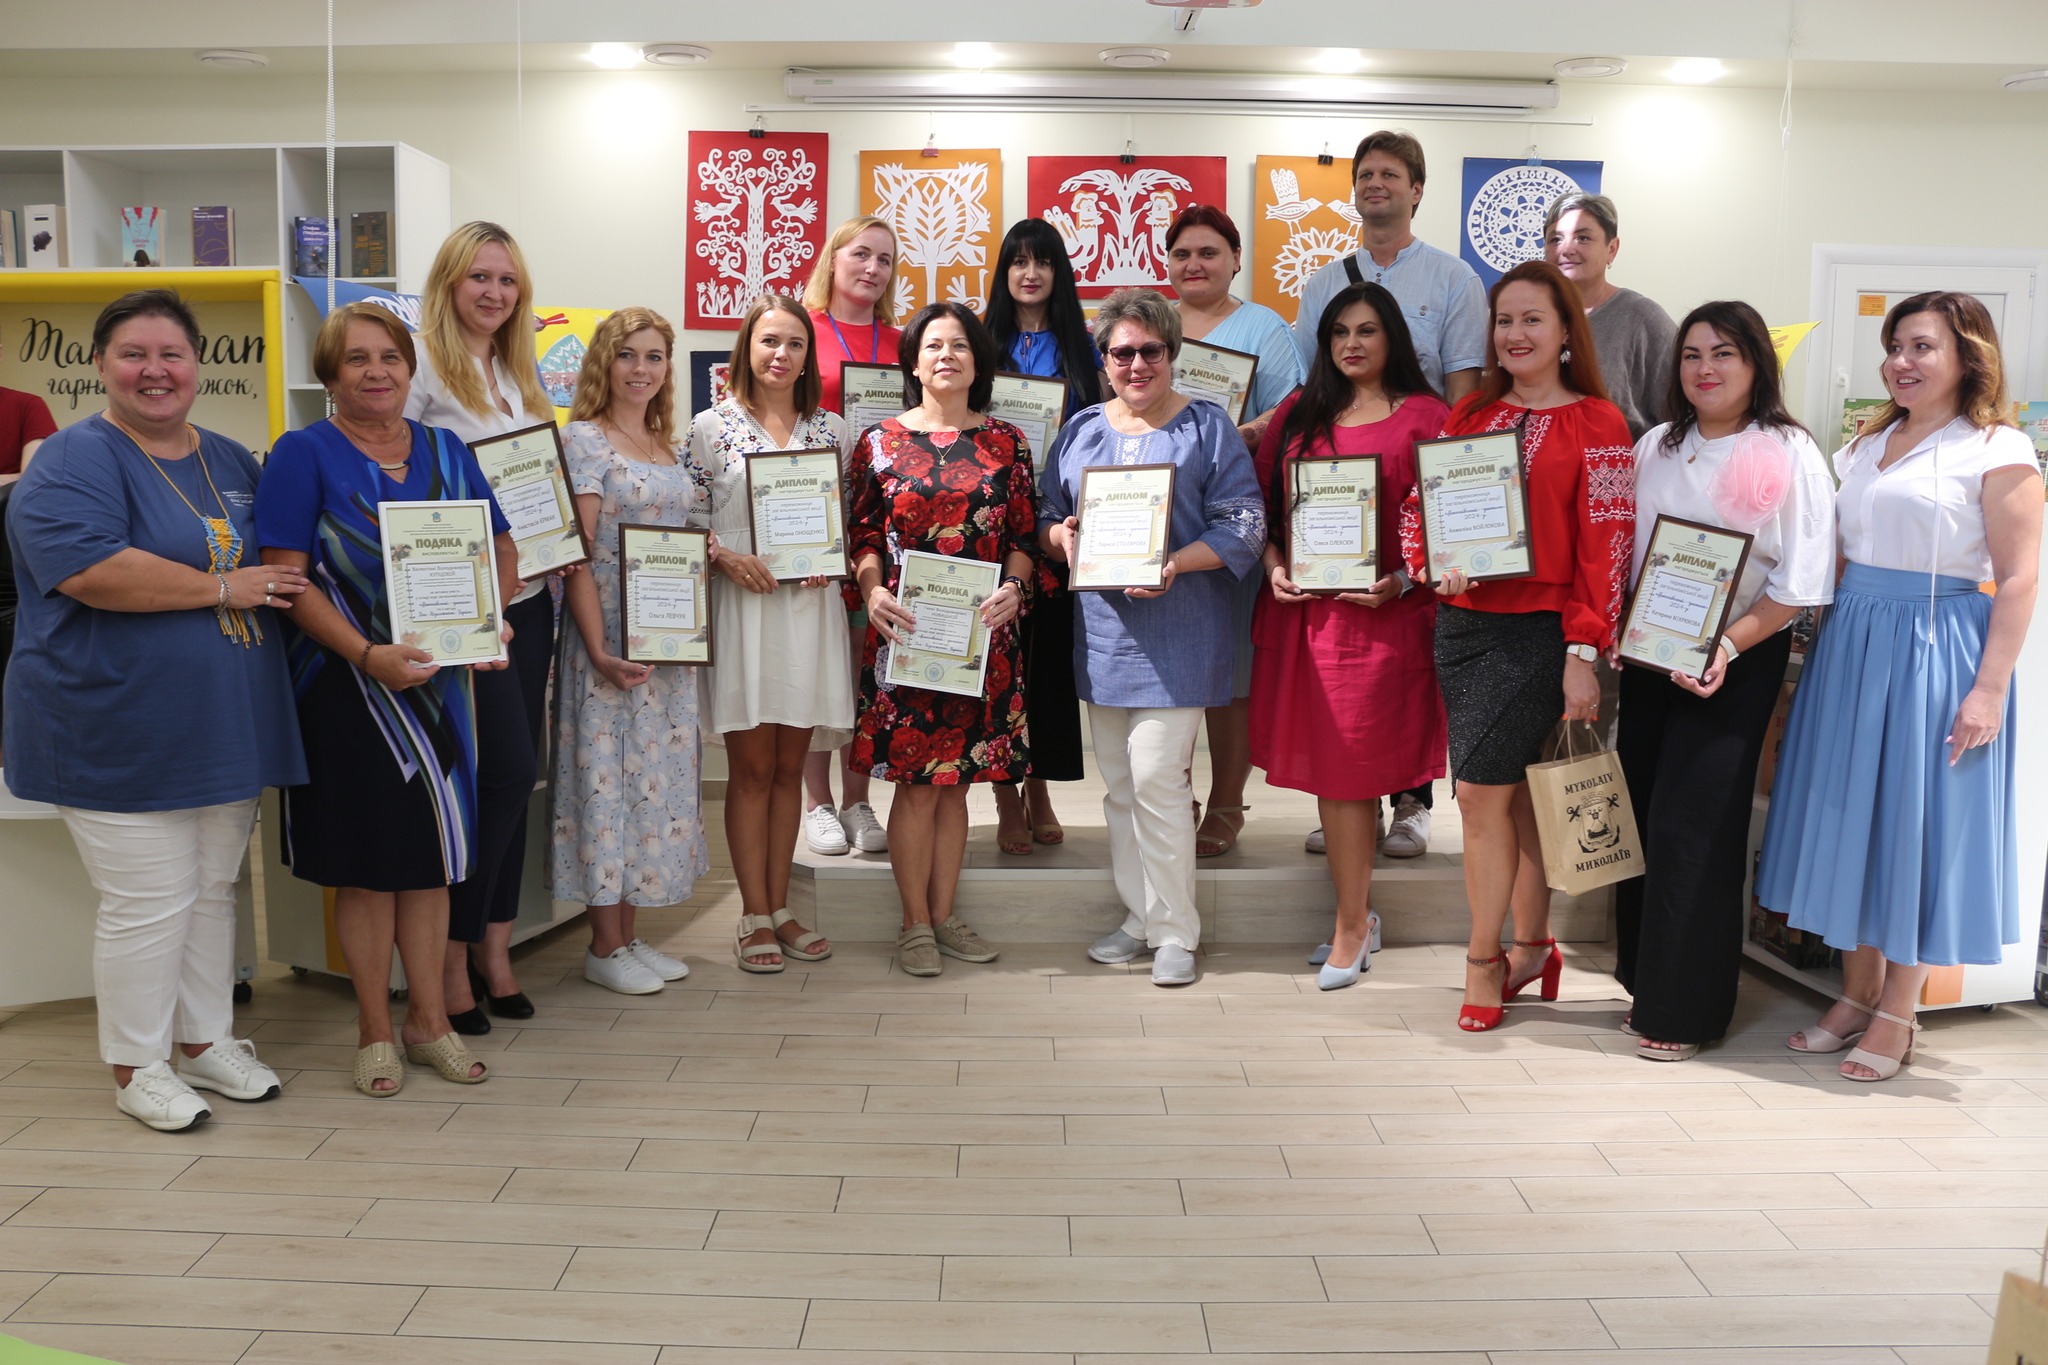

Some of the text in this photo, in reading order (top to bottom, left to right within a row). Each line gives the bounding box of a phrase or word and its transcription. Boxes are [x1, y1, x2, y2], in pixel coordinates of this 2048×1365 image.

[1190, 368, 1230, 383] ДИПЛОМ
[865, 390, 903, 398] ДИПЛОМ
[1003, 399, 1043, 410] ДИПЛОМ
[503, 459, 542, 478] ДИПЛОМ
[1447, 464, 1496, 480] ДИПЛОМ
[774, 478, 818, 489] ДИПЛОМ
[1106, 492, 1148, 501] ДИПЛОМ
[1313, 486, 1355, 496] ДИПЛОМ
[415, 537, 463, 549] ПОДЯКА
[645, 555, 687, 565] ДИПЛОМ
[1672, 552, 1717, 570] ДИПЛОМ
[928, 583, 969, 597] ПОДЯКА
[1575, 849, 1632, 872] МИКОЛАЇВ
